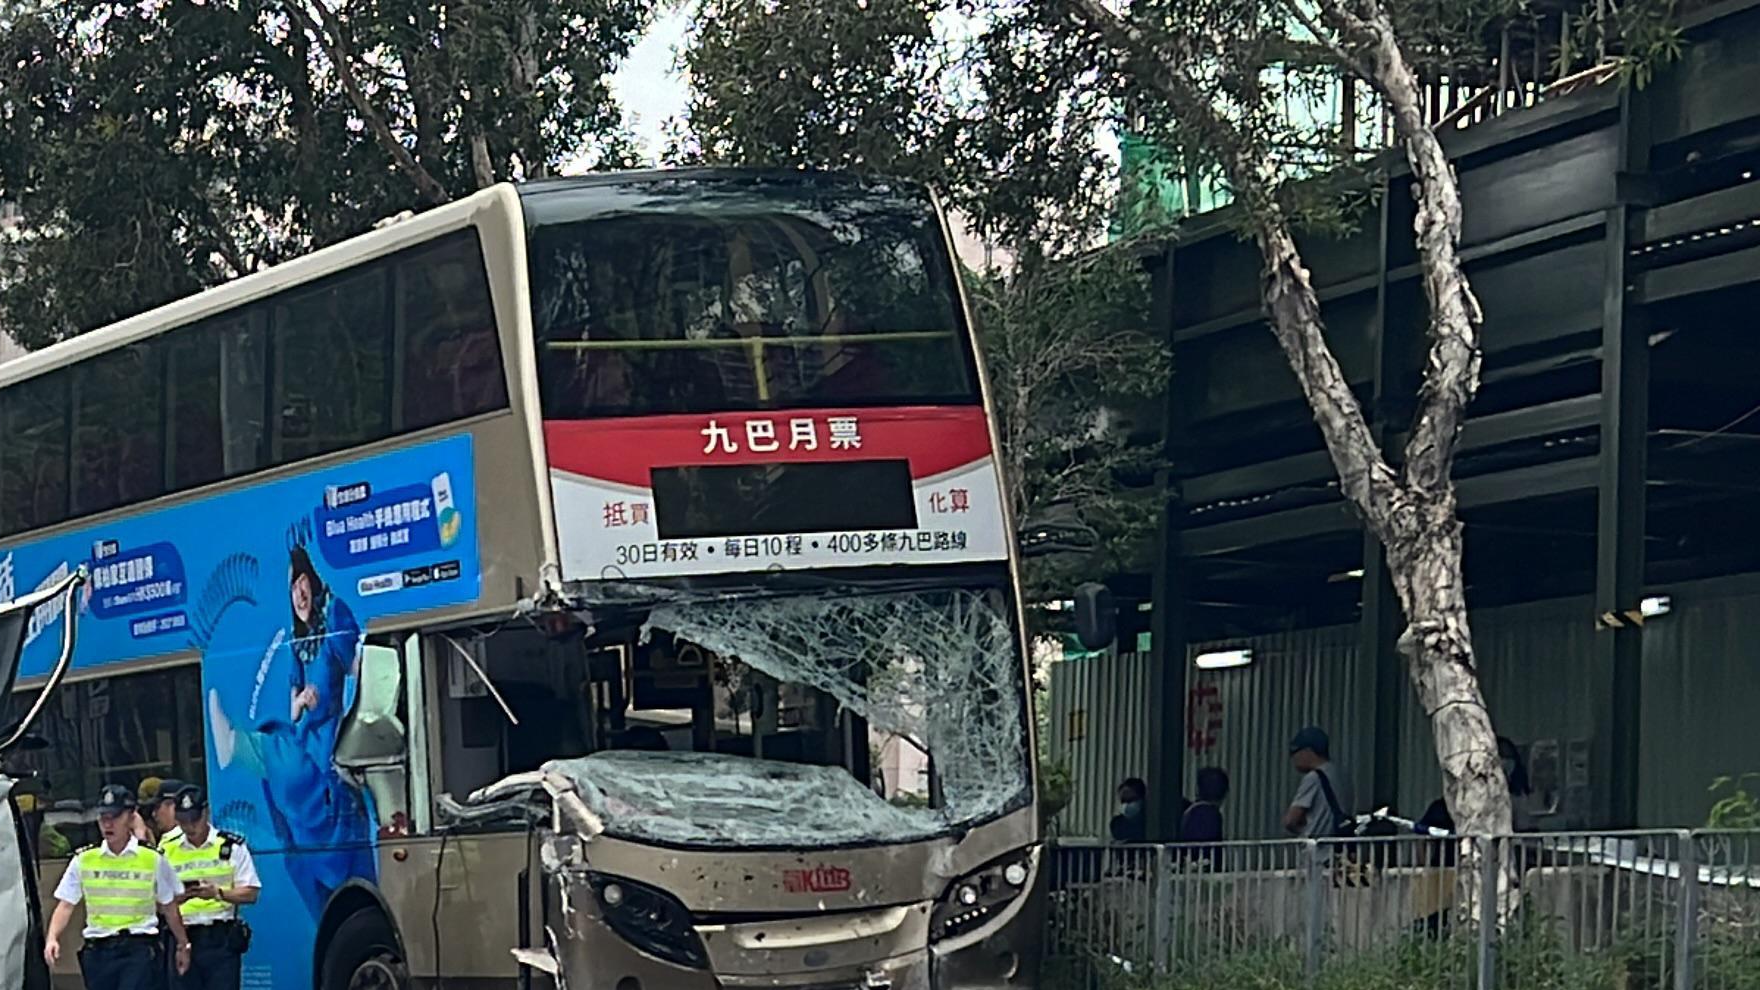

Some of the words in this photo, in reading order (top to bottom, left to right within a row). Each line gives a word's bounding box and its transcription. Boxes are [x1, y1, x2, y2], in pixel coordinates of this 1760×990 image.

[700, 416, 863, 455] 九巴月票
[603, 501, 651, 528] 抵買
[929, 488, 970, 514] 化算
[616, 541, 698, 566] 30日有效
[725, 534, 803, 559] 每日10程
[827, 530, 968, 555] 400多條九巴路線
